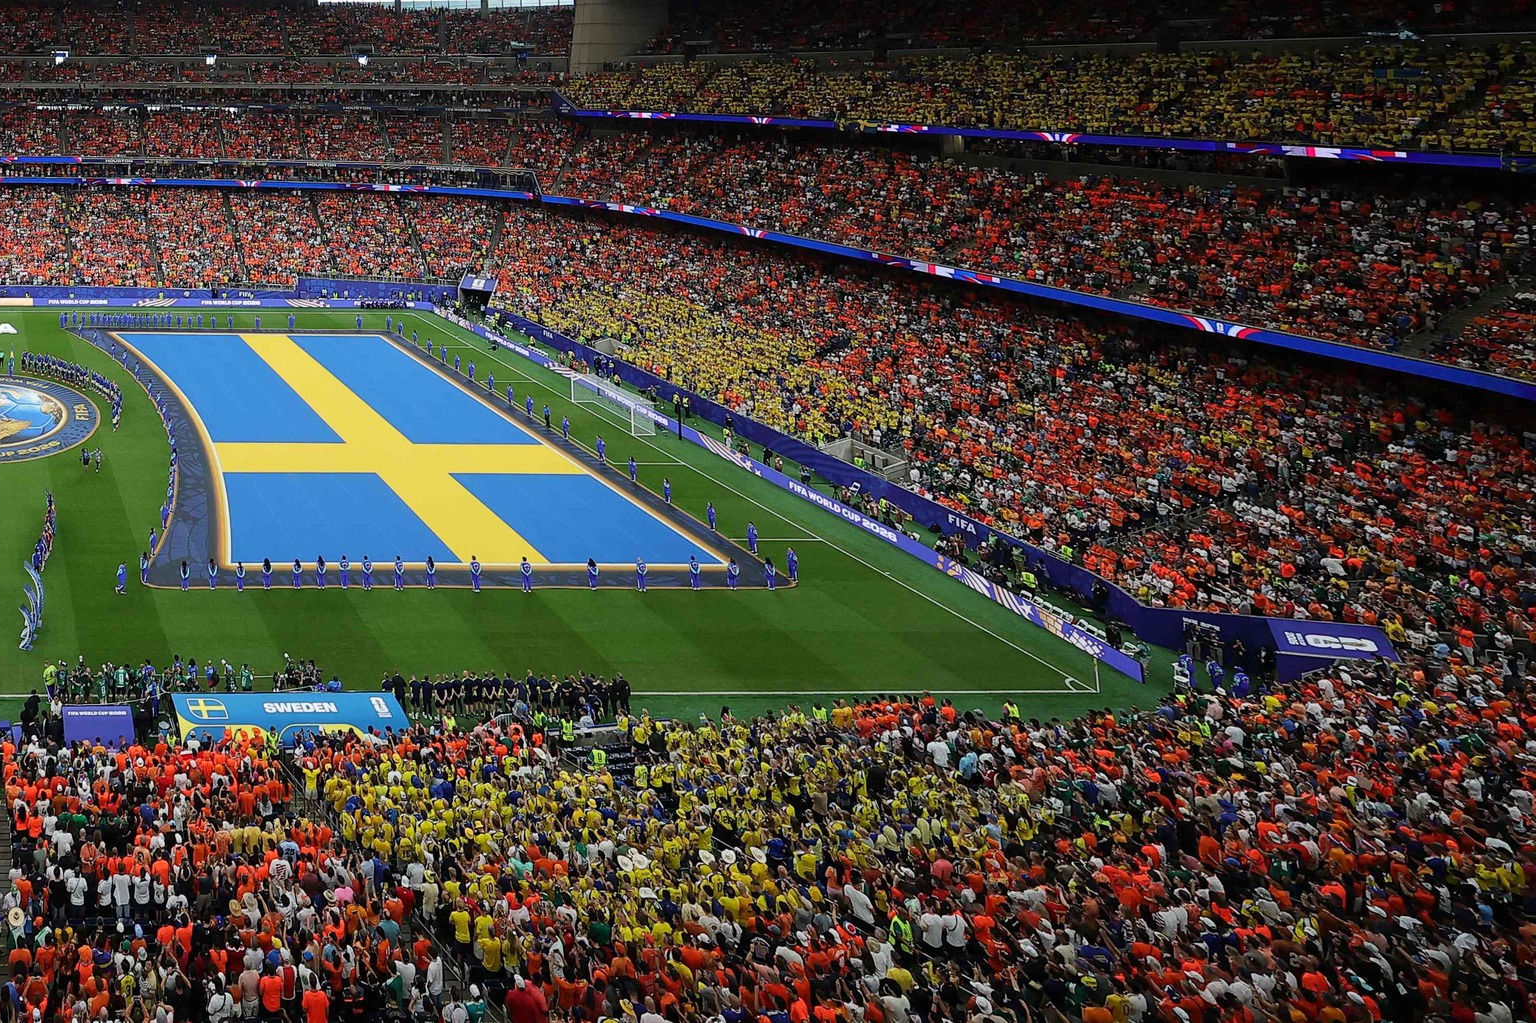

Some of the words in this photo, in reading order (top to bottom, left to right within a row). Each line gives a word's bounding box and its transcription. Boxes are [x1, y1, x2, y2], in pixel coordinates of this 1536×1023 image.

[75, 403, 85, 421] FIFA
[17, 440, 61, 456] 2026
[788, 480, 809, 498] FIFA
[807, 491, 842, 514] WORLD
[841, 507, 861, 523] CUP
[861, 518, 898, 543] 2026
[947, 513, 977, 535] FIFA
[263, 701, 338, 714] SWEDEN
